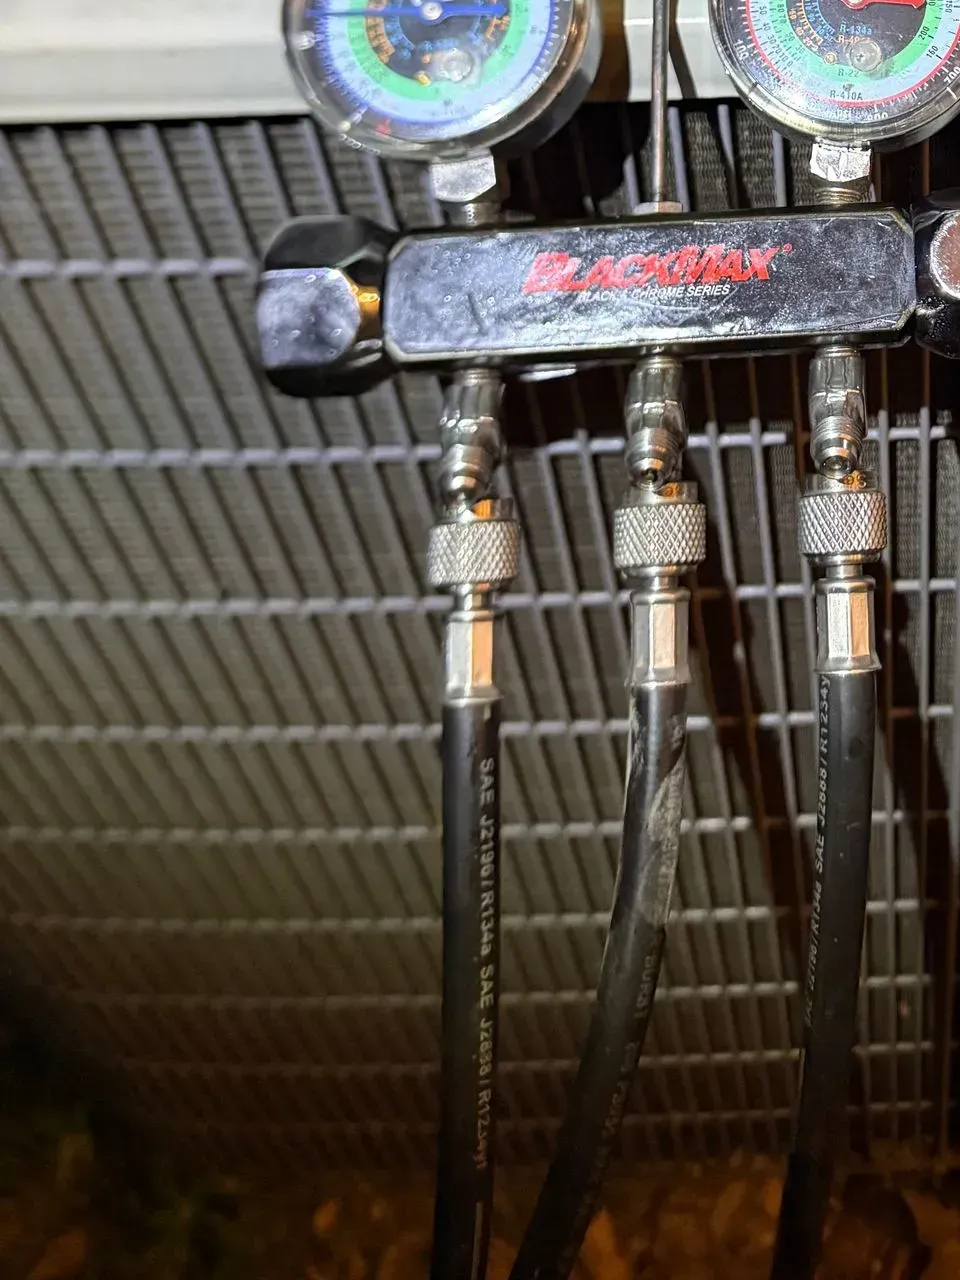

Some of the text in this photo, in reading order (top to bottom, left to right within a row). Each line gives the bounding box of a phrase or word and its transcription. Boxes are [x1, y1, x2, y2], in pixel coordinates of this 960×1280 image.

[918, 26, 930, 41] 200
[926, 45, 939, 59] 160
[687, 284, 730, 297] SERIES
[480, 758, 494, 806] SAE
[480, 964, 494, 1008] SAE
